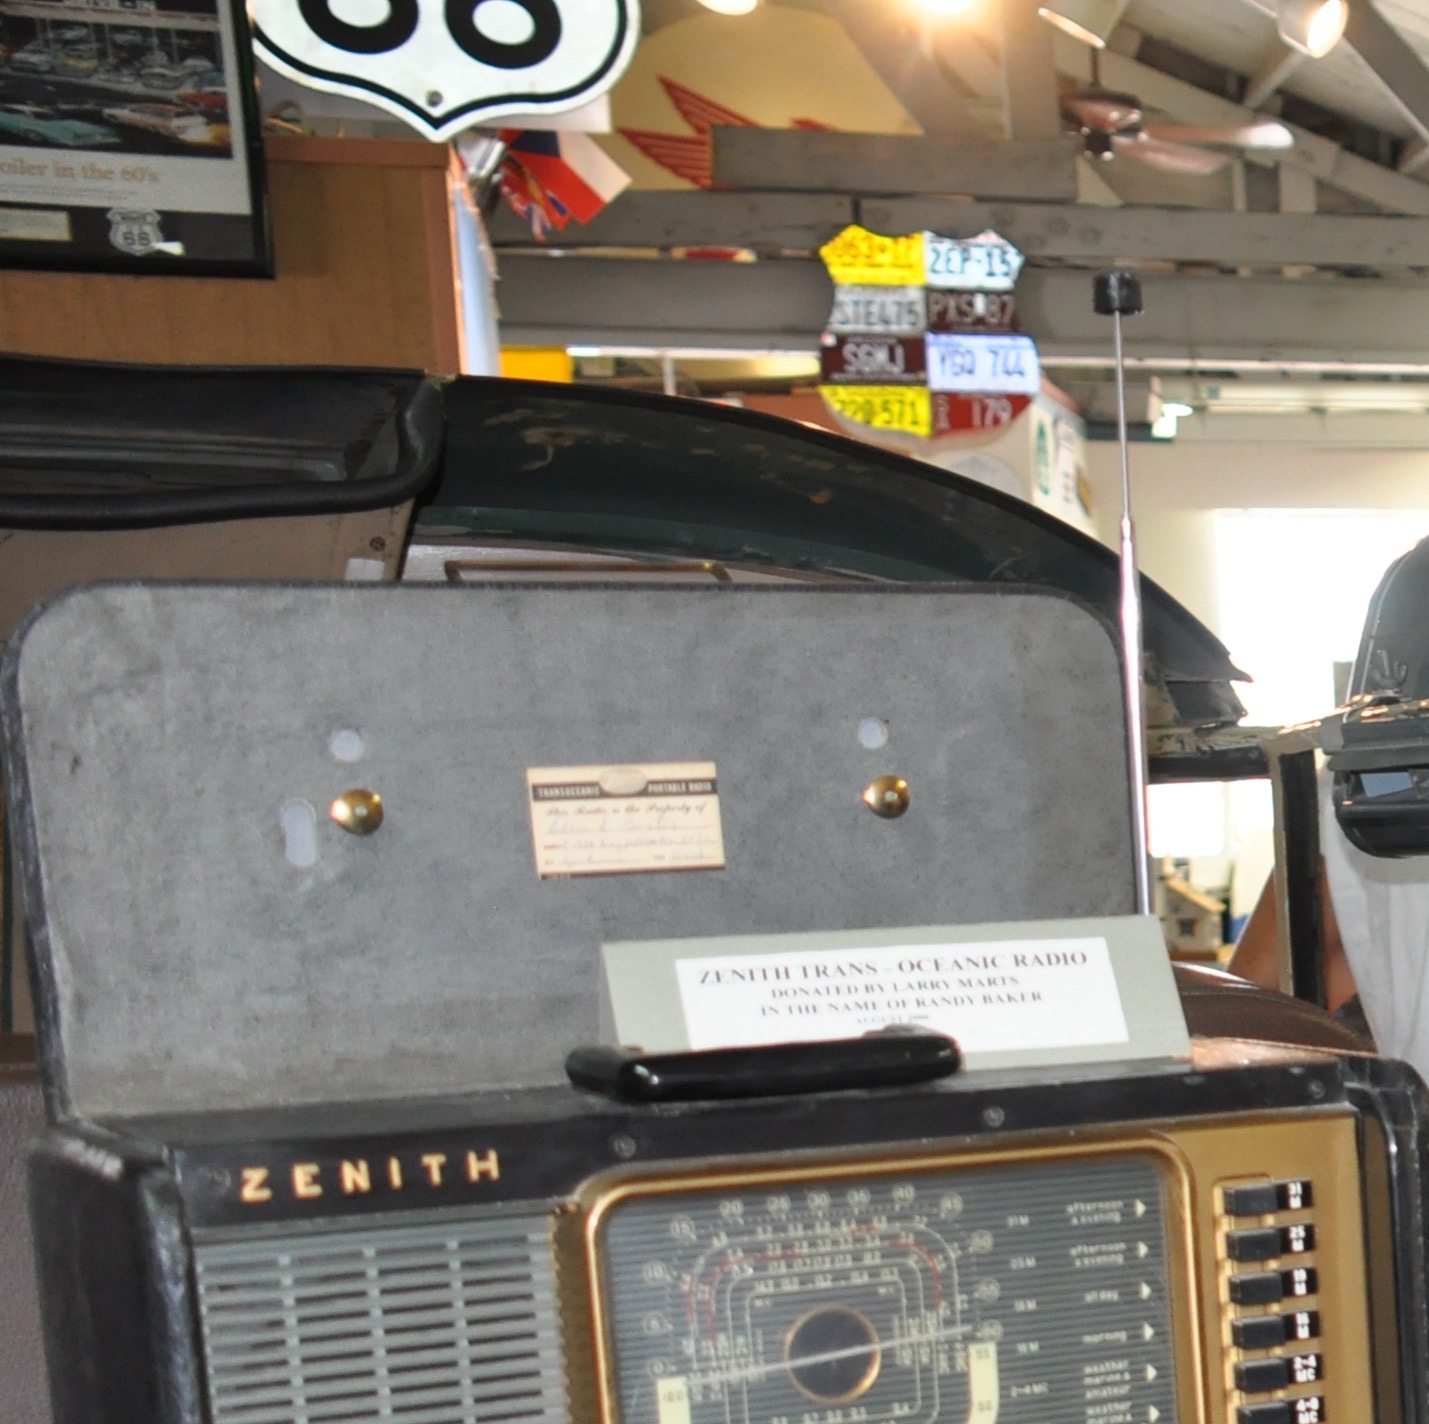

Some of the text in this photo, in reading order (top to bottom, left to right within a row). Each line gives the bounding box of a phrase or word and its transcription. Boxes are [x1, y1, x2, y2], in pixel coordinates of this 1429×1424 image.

[648, 782, 686, 794] PORTABLE
[698, 950, 1089, 985] ZENITH TRANS OCEANIC RADIO
[771, 984, 860, 1000] DONATED
[864, 982, 887, 996] BY
[890, 979, 954, 994] LARRY
[760, 990, 1043, 1016] IN THE NAME OF RANDY BAKER
[239, 1149, 500, 1203] ZENITH
